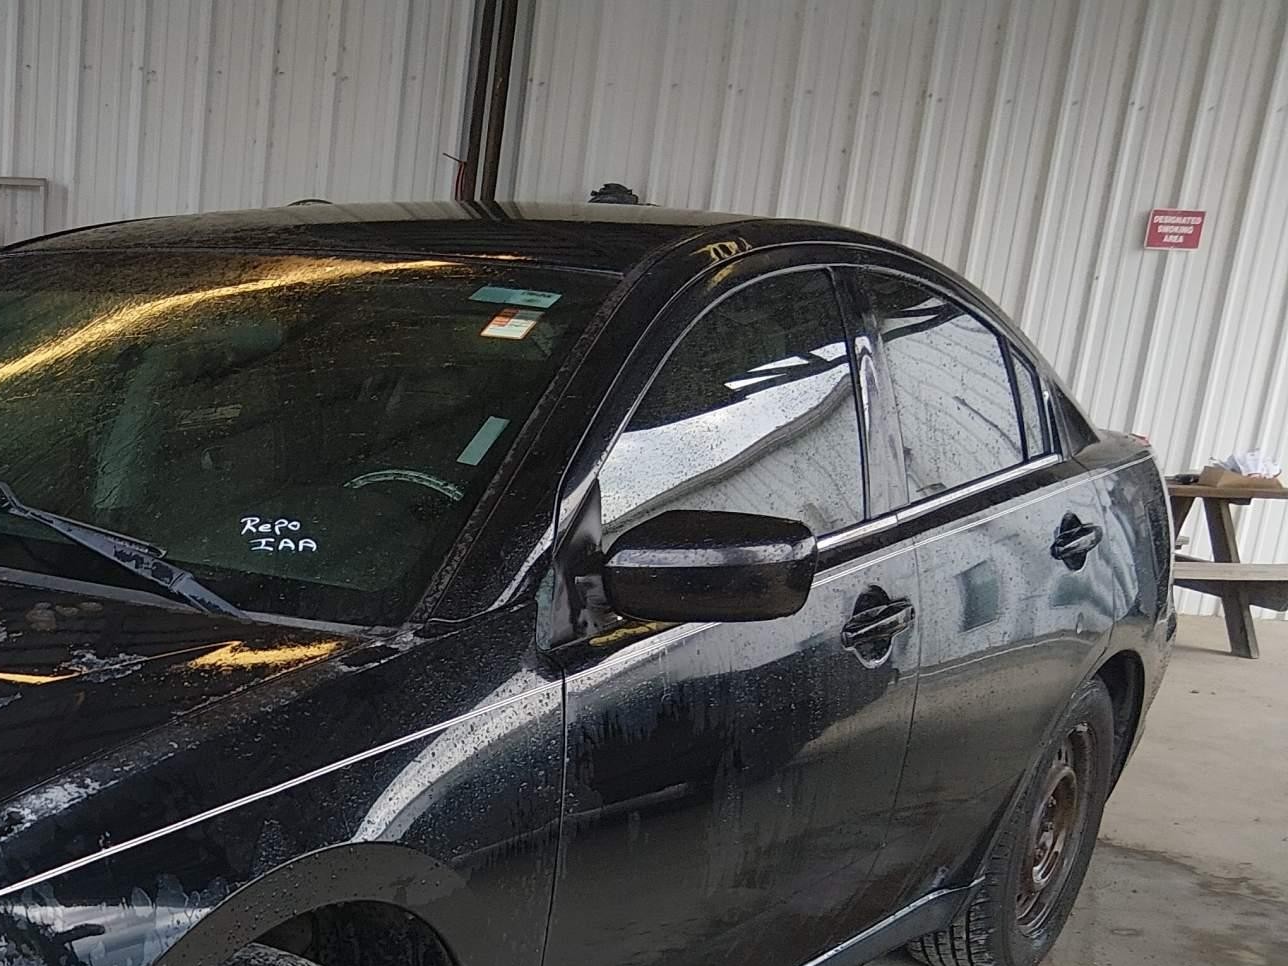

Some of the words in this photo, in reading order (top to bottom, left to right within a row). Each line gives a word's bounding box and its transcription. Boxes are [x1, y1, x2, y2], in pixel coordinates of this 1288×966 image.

[1153, 215, 1202, 225] DESIGNATED
[1157, 225, 1194, 234] SMOKING
[1162, 234, 1184, 243] AREA
[249, 537, 318, 552] IAA
